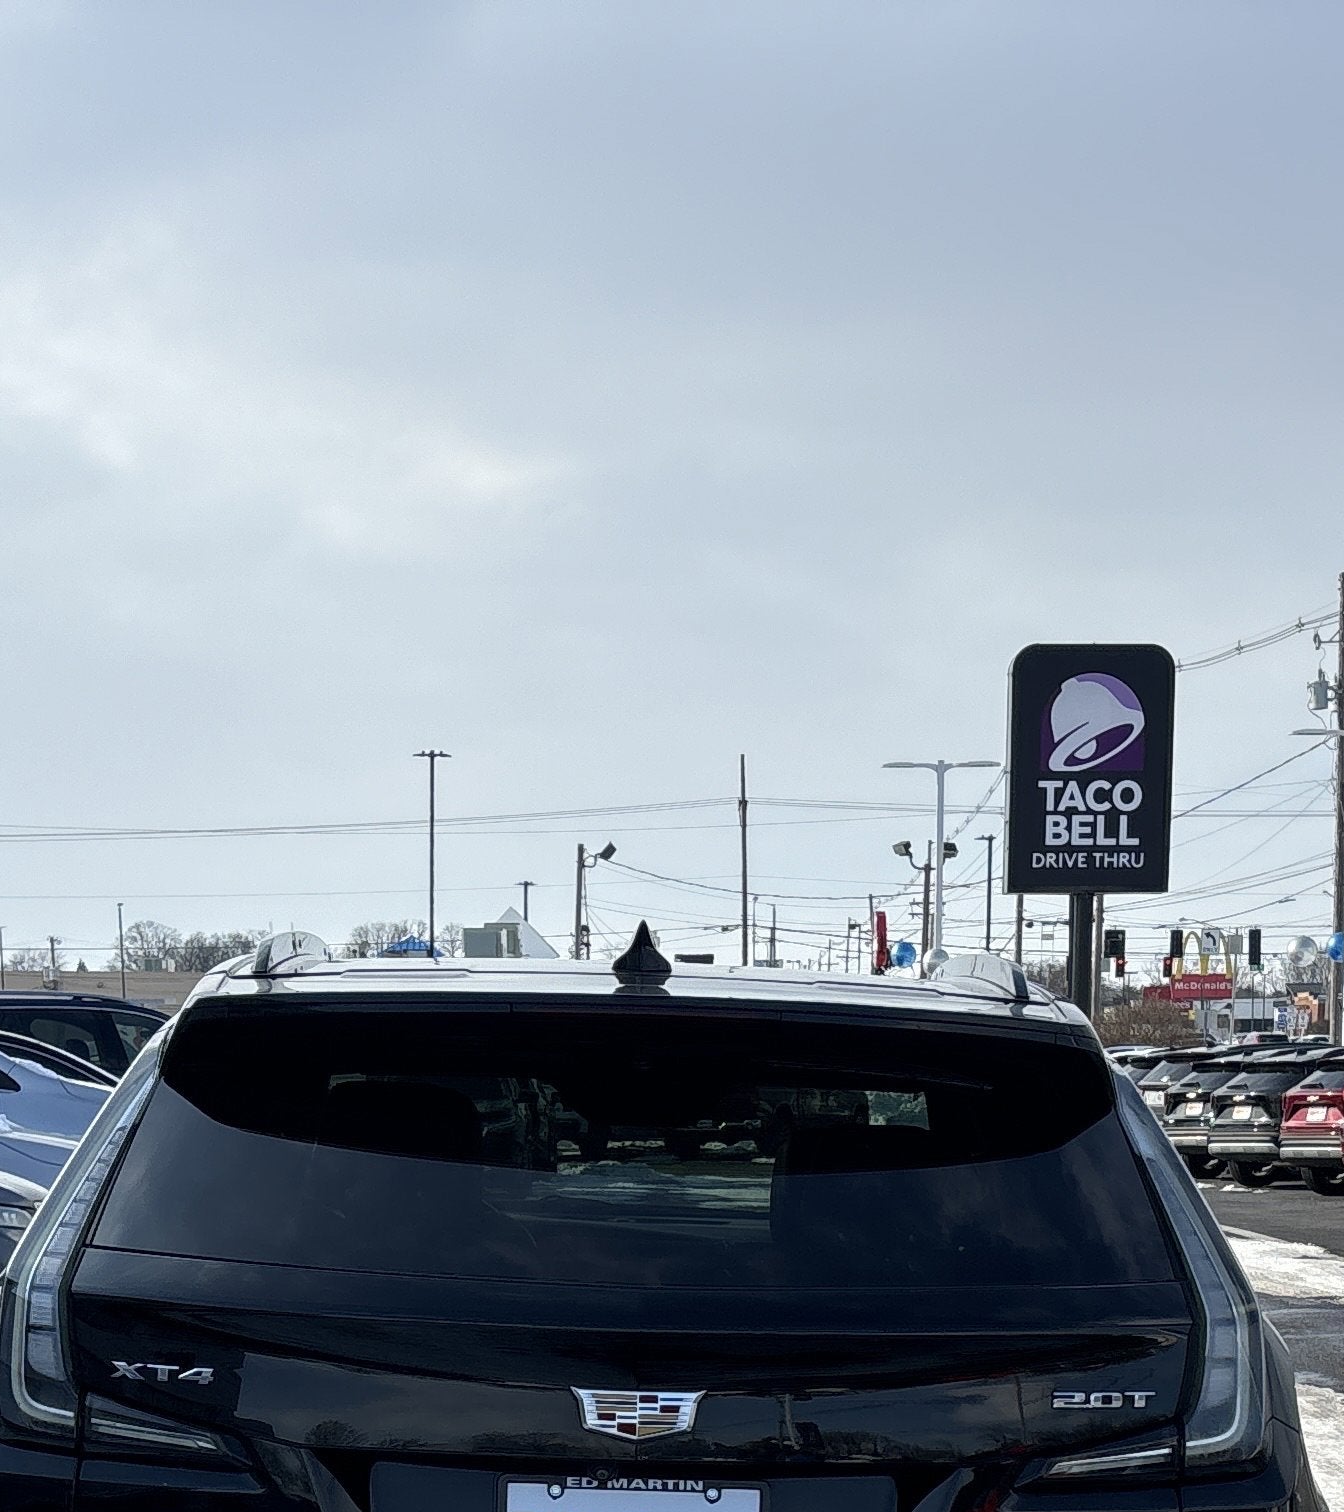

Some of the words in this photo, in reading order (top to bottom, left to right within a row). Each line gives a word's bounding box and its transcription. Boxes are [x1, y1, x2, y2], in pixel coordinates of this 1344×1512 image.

[1037, 779, 1143, 812] TACO
[1045, 814, 1140, 845] BELL
[1031, 852, 1088, 869] DRIVE
[1092, 852, 1145, 869] THRU
[110, 1360, 215, 1385] XT4
[1052, 1391, 1156, 1409] 2.0T
[566, 1476, 599, 1489] ED
[607, 1478, 704, 1491] MARTIN
